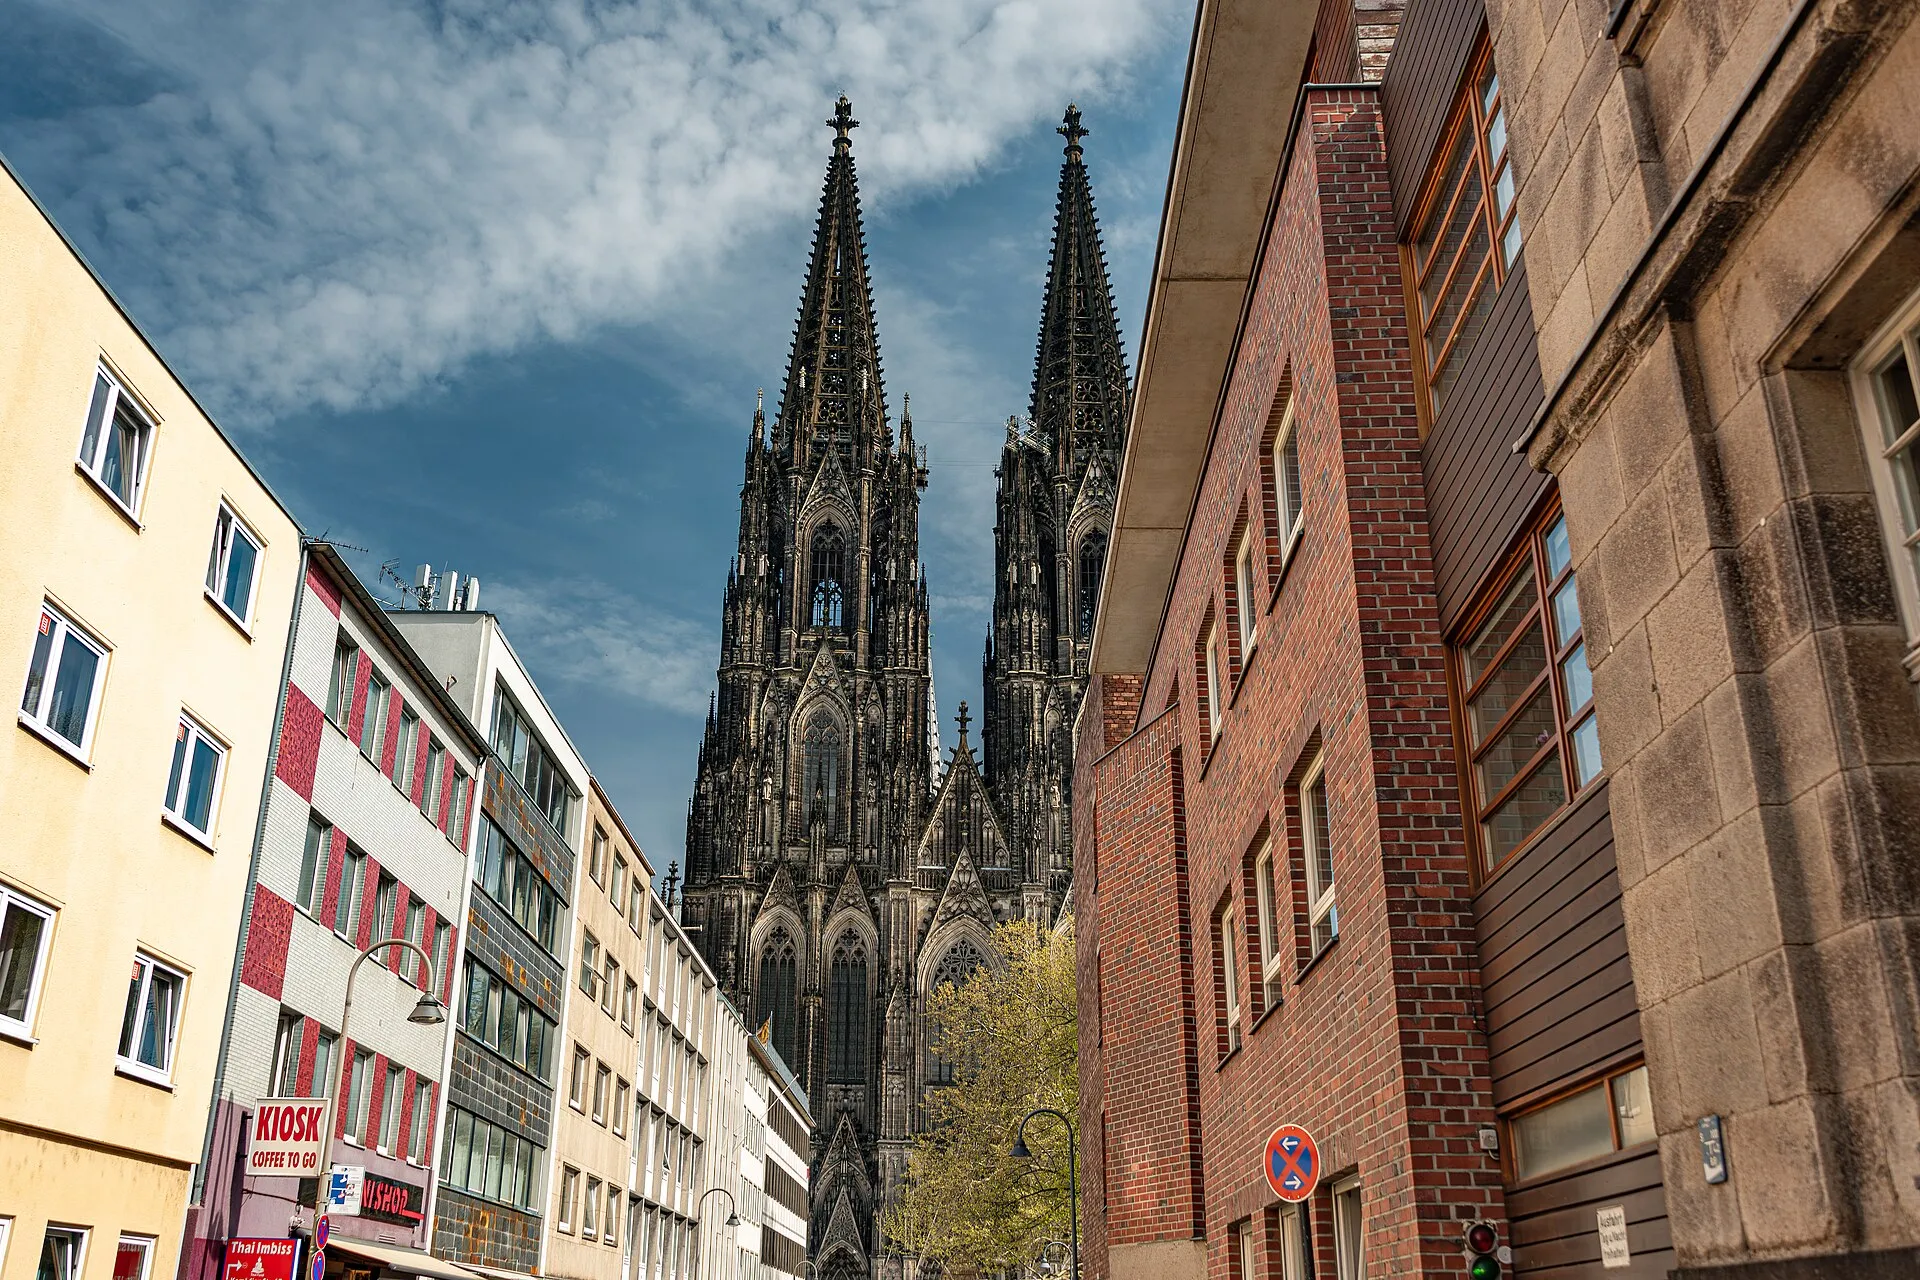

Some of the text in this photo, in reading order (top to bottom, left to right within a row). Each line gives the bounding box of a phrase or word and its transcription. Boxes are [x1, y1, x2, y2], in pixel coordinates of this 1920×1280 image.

[256, 1105, 323, 1142] KIOSK
[252, 1151, 317, 1168] COFFEE TO GO
[231, 1241, 293, 1255] Thai Imbiss
